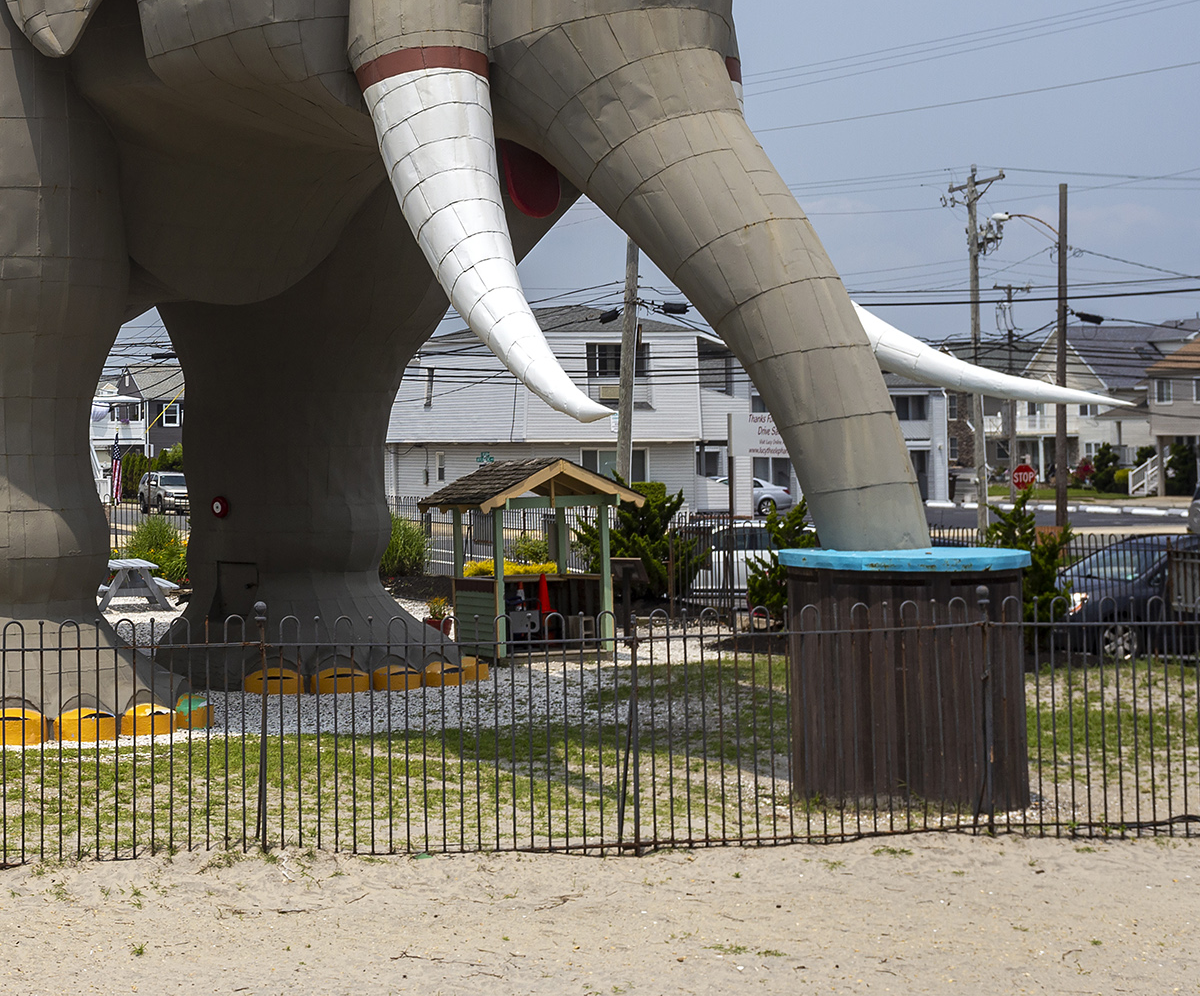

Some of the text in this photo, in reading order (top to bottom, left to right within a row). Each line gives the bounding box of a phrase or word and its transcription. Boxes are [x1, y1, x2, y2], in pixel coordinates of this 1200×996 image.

[749, 414, 766, 423] Thanks
[758, 426, 770, 435] Drive
[1013, 472, 1035, 483] STOP
